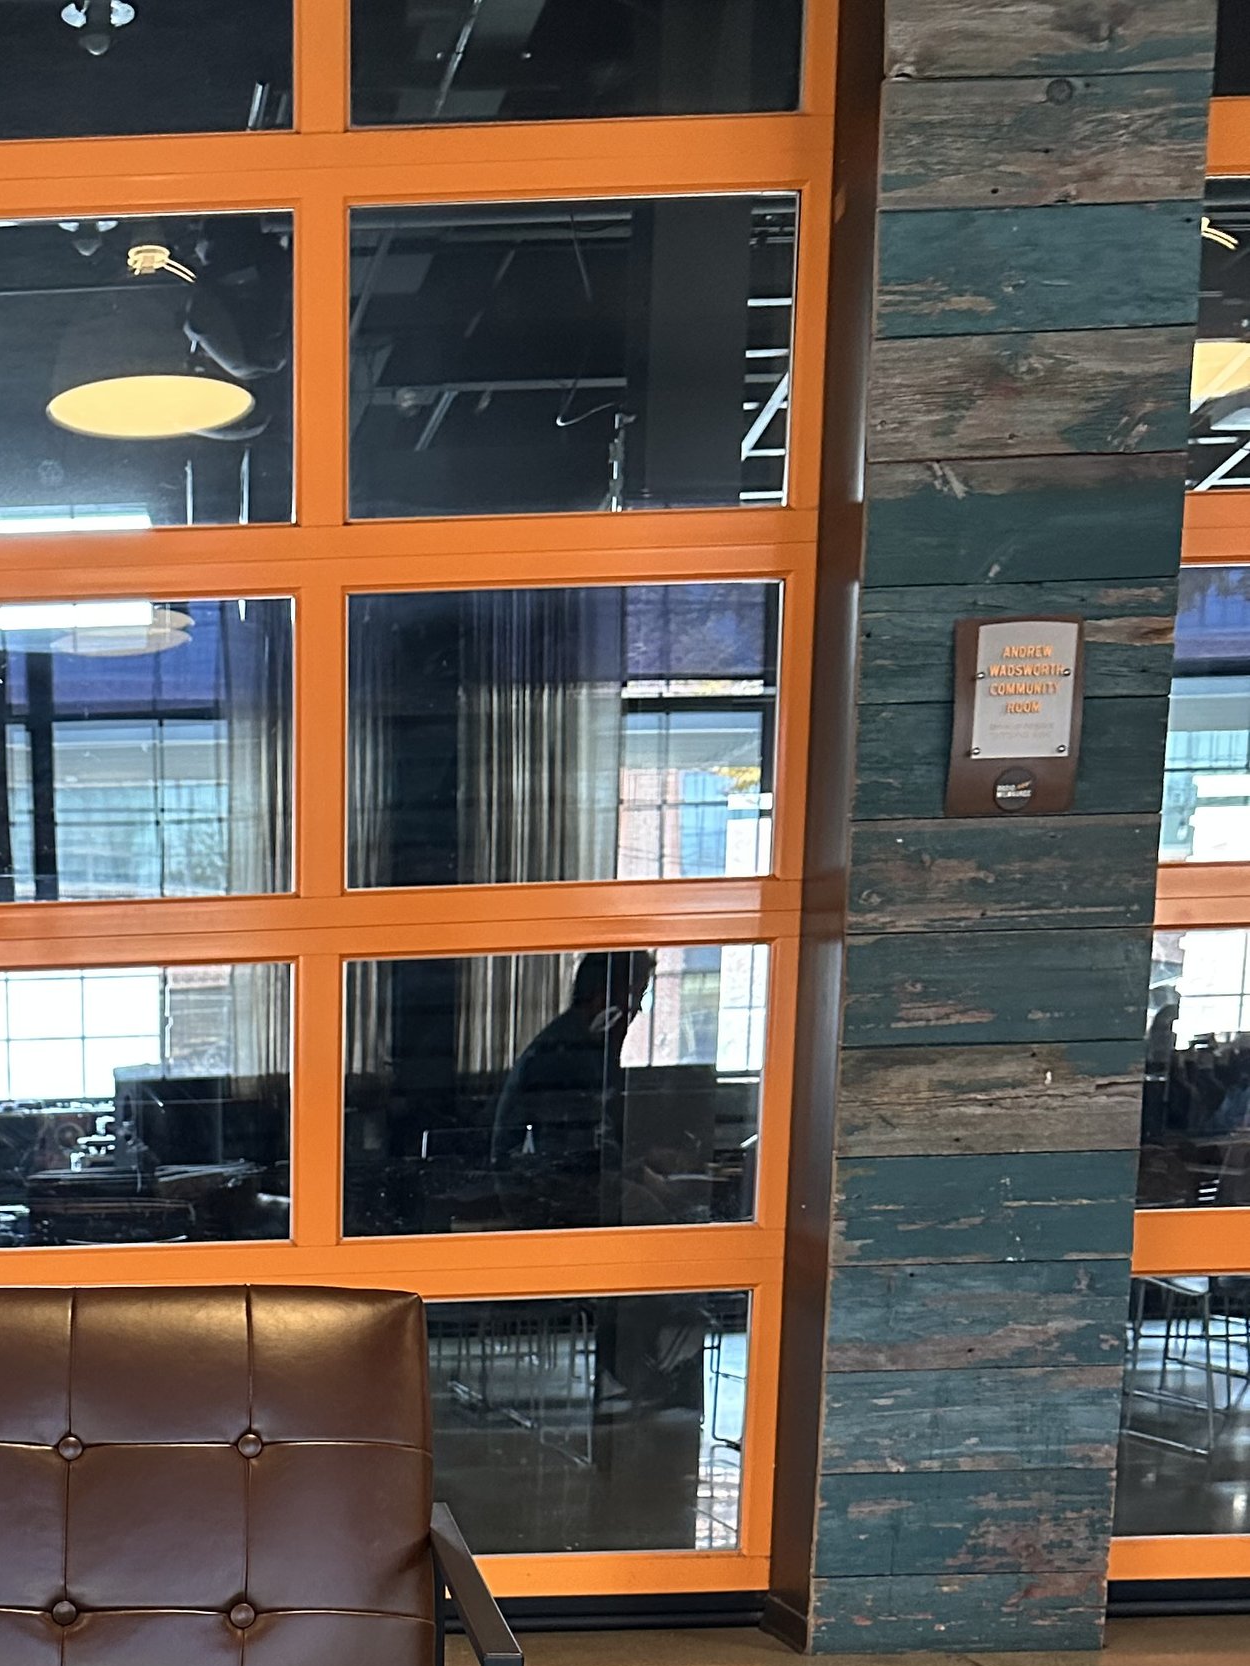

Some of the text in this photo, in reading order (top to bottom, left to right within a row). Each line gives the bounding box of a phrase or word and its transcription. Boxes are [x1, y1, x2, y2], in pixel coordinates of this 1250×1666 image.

[1003, 646, 1053, 658] ANDREW
[989, 664, 1064, 676] WADSWORTH
[989, 682, 1059, 695] COMMUNITY
[1006, 701, 1041, 713] ROOM
